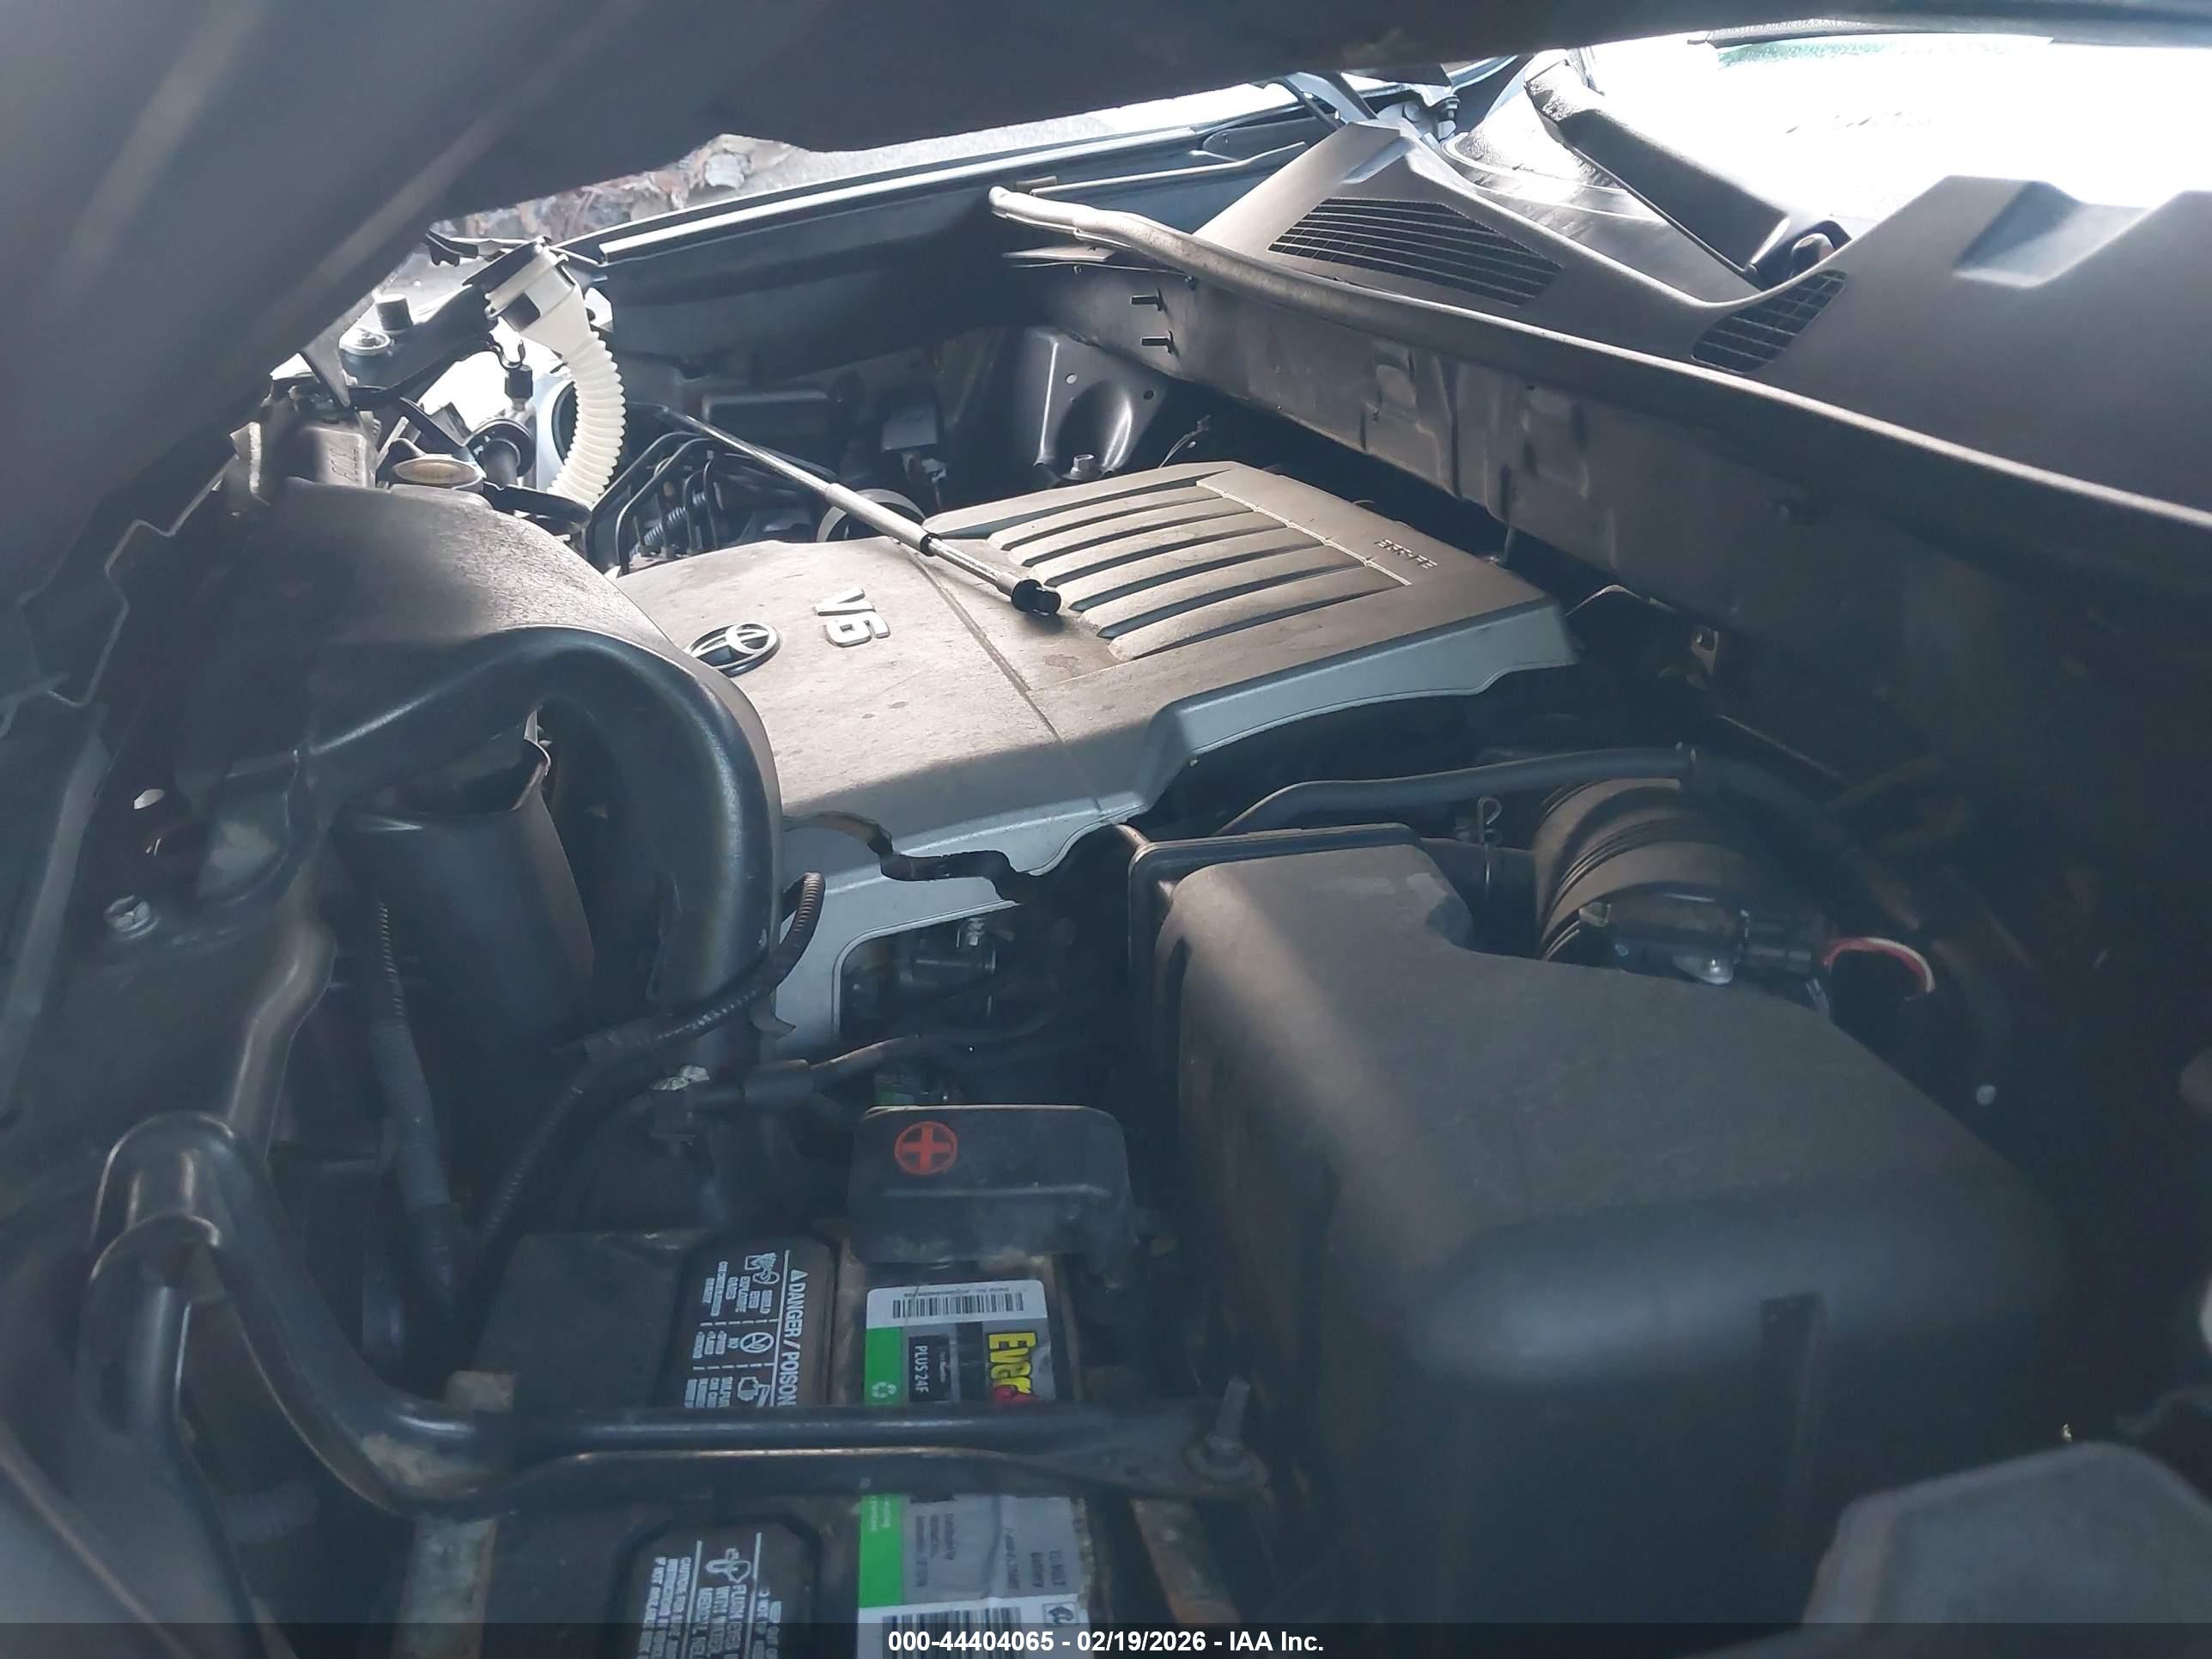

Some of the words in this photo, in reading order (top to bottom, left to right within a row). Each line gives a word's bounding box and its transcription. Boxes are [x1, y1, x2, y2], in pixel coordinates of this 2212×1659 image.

[814, 587, 890, 648] V6
[784, 1282, 806, 1338] DANGER
[776, 1352, 800, 1406] POISON
[915, 1345, 928, 1373] PLUS
[915, 1374, 929, 1393] 24F
